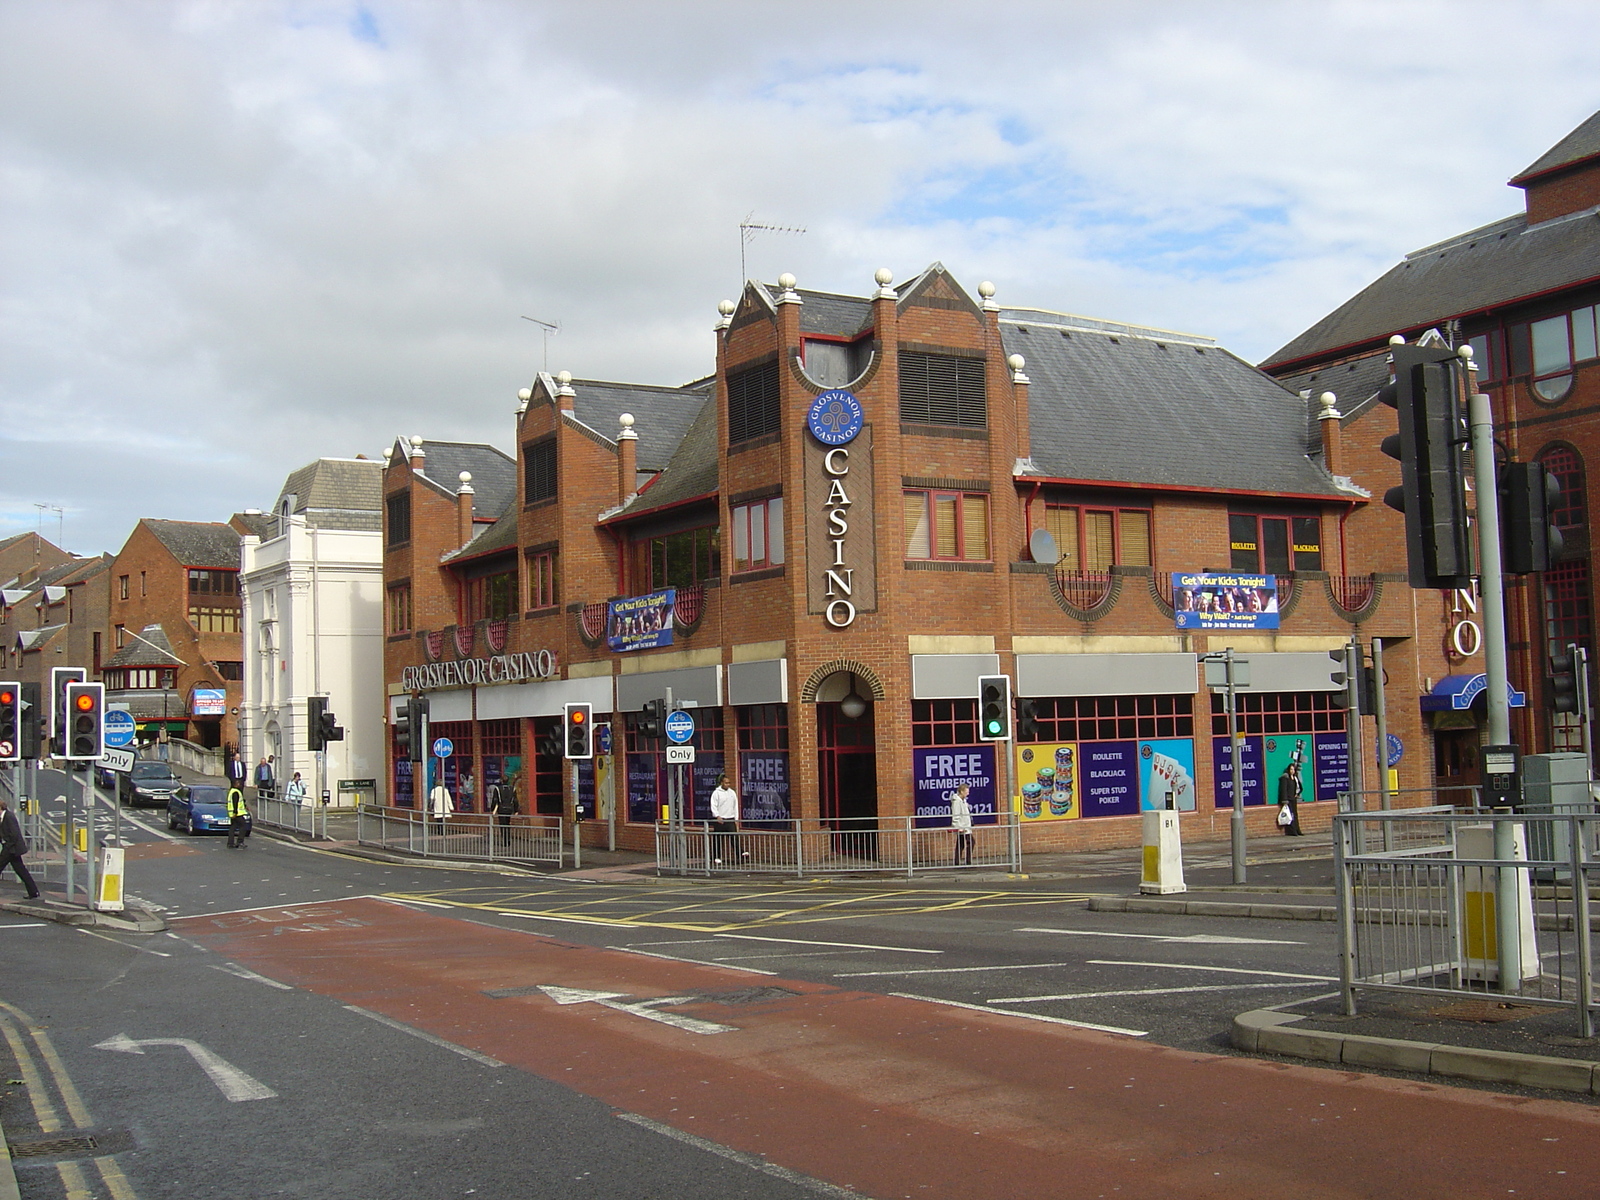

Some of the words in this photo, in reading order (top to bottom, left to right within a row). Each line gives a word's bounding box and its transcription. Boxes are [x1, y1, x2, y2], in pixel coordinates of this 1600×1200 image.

[811, 393, 860, 420] GROSVENOR
[814, 425, 857, 442] CASINOS
[824, 448, 856, 627] CASINO
[1181, 576, 1196, 586] Get
[1198, 577, 1217, 586] Your
[1218, 576, 1237, 586] Kicks
[1238, 577, 1266, 588] Tonight!
[615, 603, 624, 612] Get
[624, 601, 635, 610] Your
[635, 599, 648, 609] Kicks
[648, 594, 667, 607] Tonight!
[1199, 612, 1213, 621] Why
[1213, 612, 1231, 620] Wait?
[402, 657, 487, 690] GROSVENOR
[489, 649, 552, 682] CASINO
[102, 752, 129, 766] Only
[670, 750, 692, 759] Only
[747, 758, 783, 780] FREE
[925, 754, 982, 777] FREE
[694, 768, 704, 776] BAR
[1090, 770, 1126, 778] BLACKJACK
[744, 782, 788, 793] MEMBERSHIP
[1090, 787, 1110, 795] SUPER
[1111, 786, 1127, 794] STUD
[757, 795, 775, 804] CALL
[1099, 796, 1120, 804] POKER
[1165, 820, 1173, 828] B1
[211, 907, 343, 929] BUS
